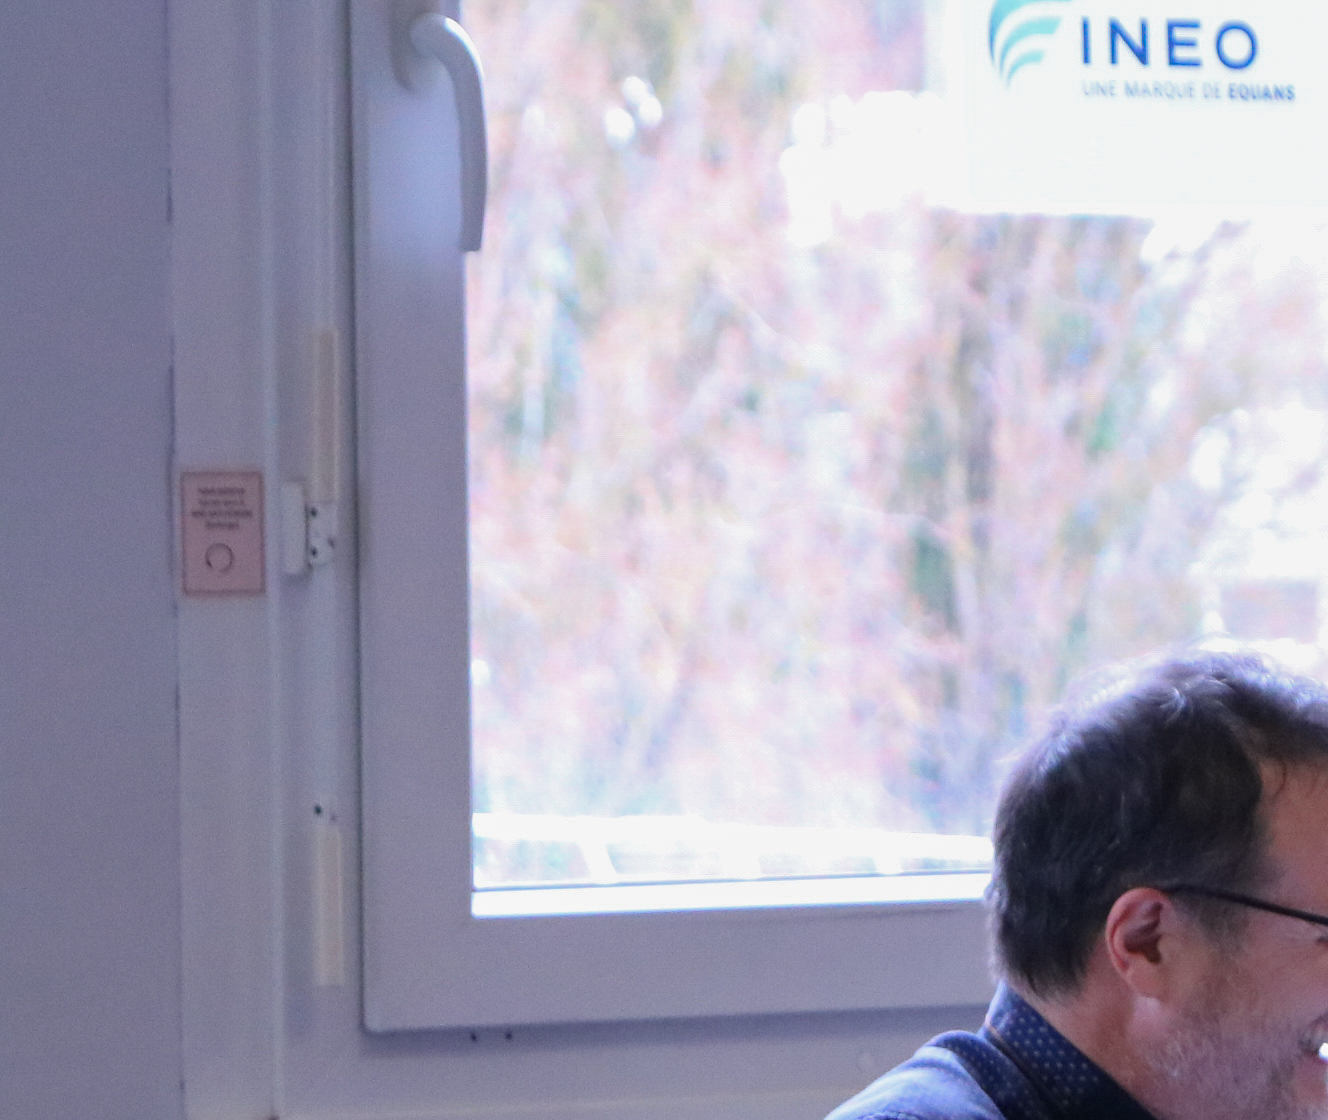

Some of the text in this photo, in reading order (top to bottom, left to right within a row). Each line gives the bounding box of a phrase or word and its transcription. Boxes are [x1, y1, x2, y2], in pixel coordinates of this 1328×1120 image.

[1080, 16, 1259, 70] INEO
[1082, 81, 1297, 101] UNE MARQUE DE EQUANS
